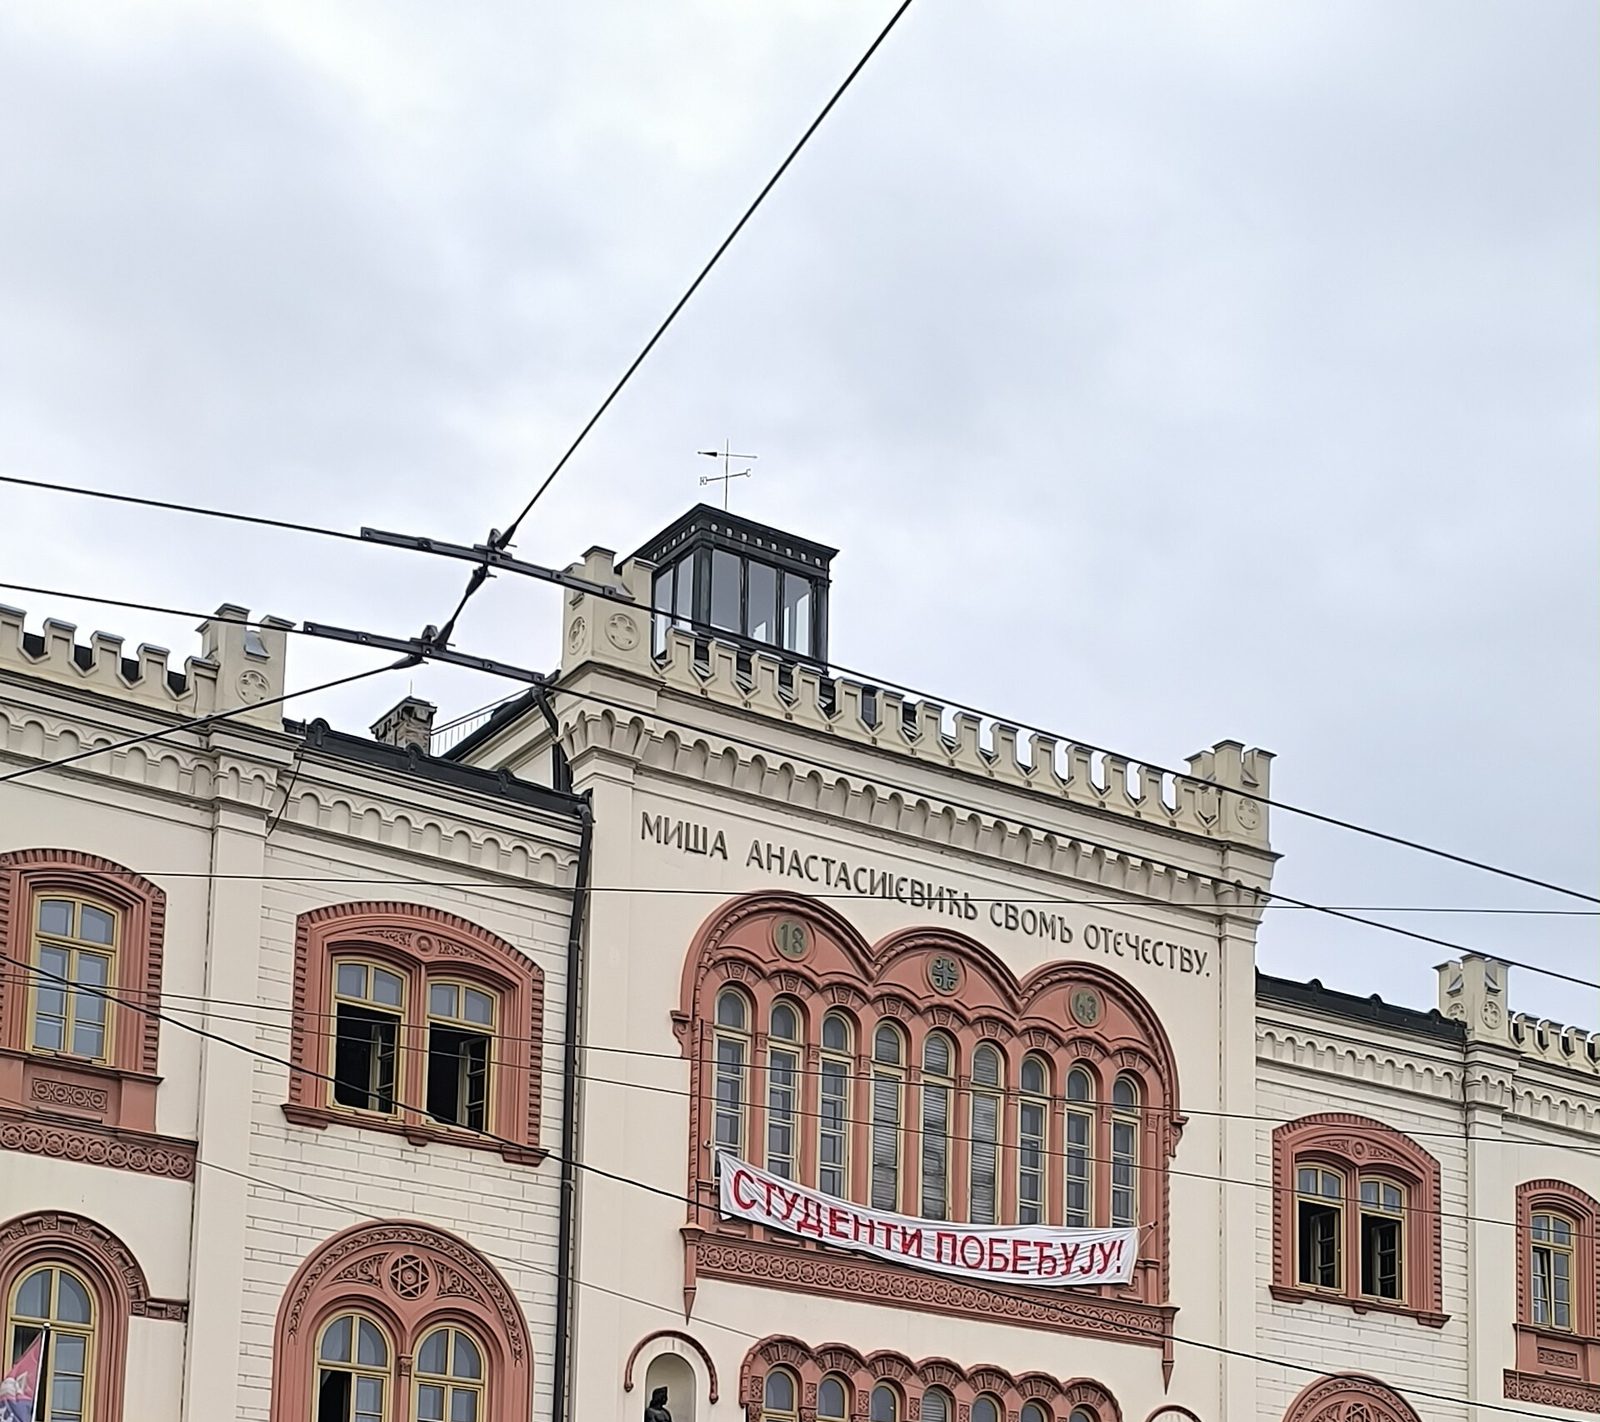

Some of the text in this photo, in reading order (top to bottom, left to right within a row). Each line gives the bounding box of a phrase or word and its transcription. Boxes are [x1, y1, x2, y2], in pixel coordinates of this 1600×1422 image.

[640, 811, 729, 860] МИША
[988, 902, 1074, 944] СВОМЪ
[780, 924, 804, 954] 18
[732, 1168, 1125, 1277] СТУДЕНТИ ПОБЕЂУЈУ!
